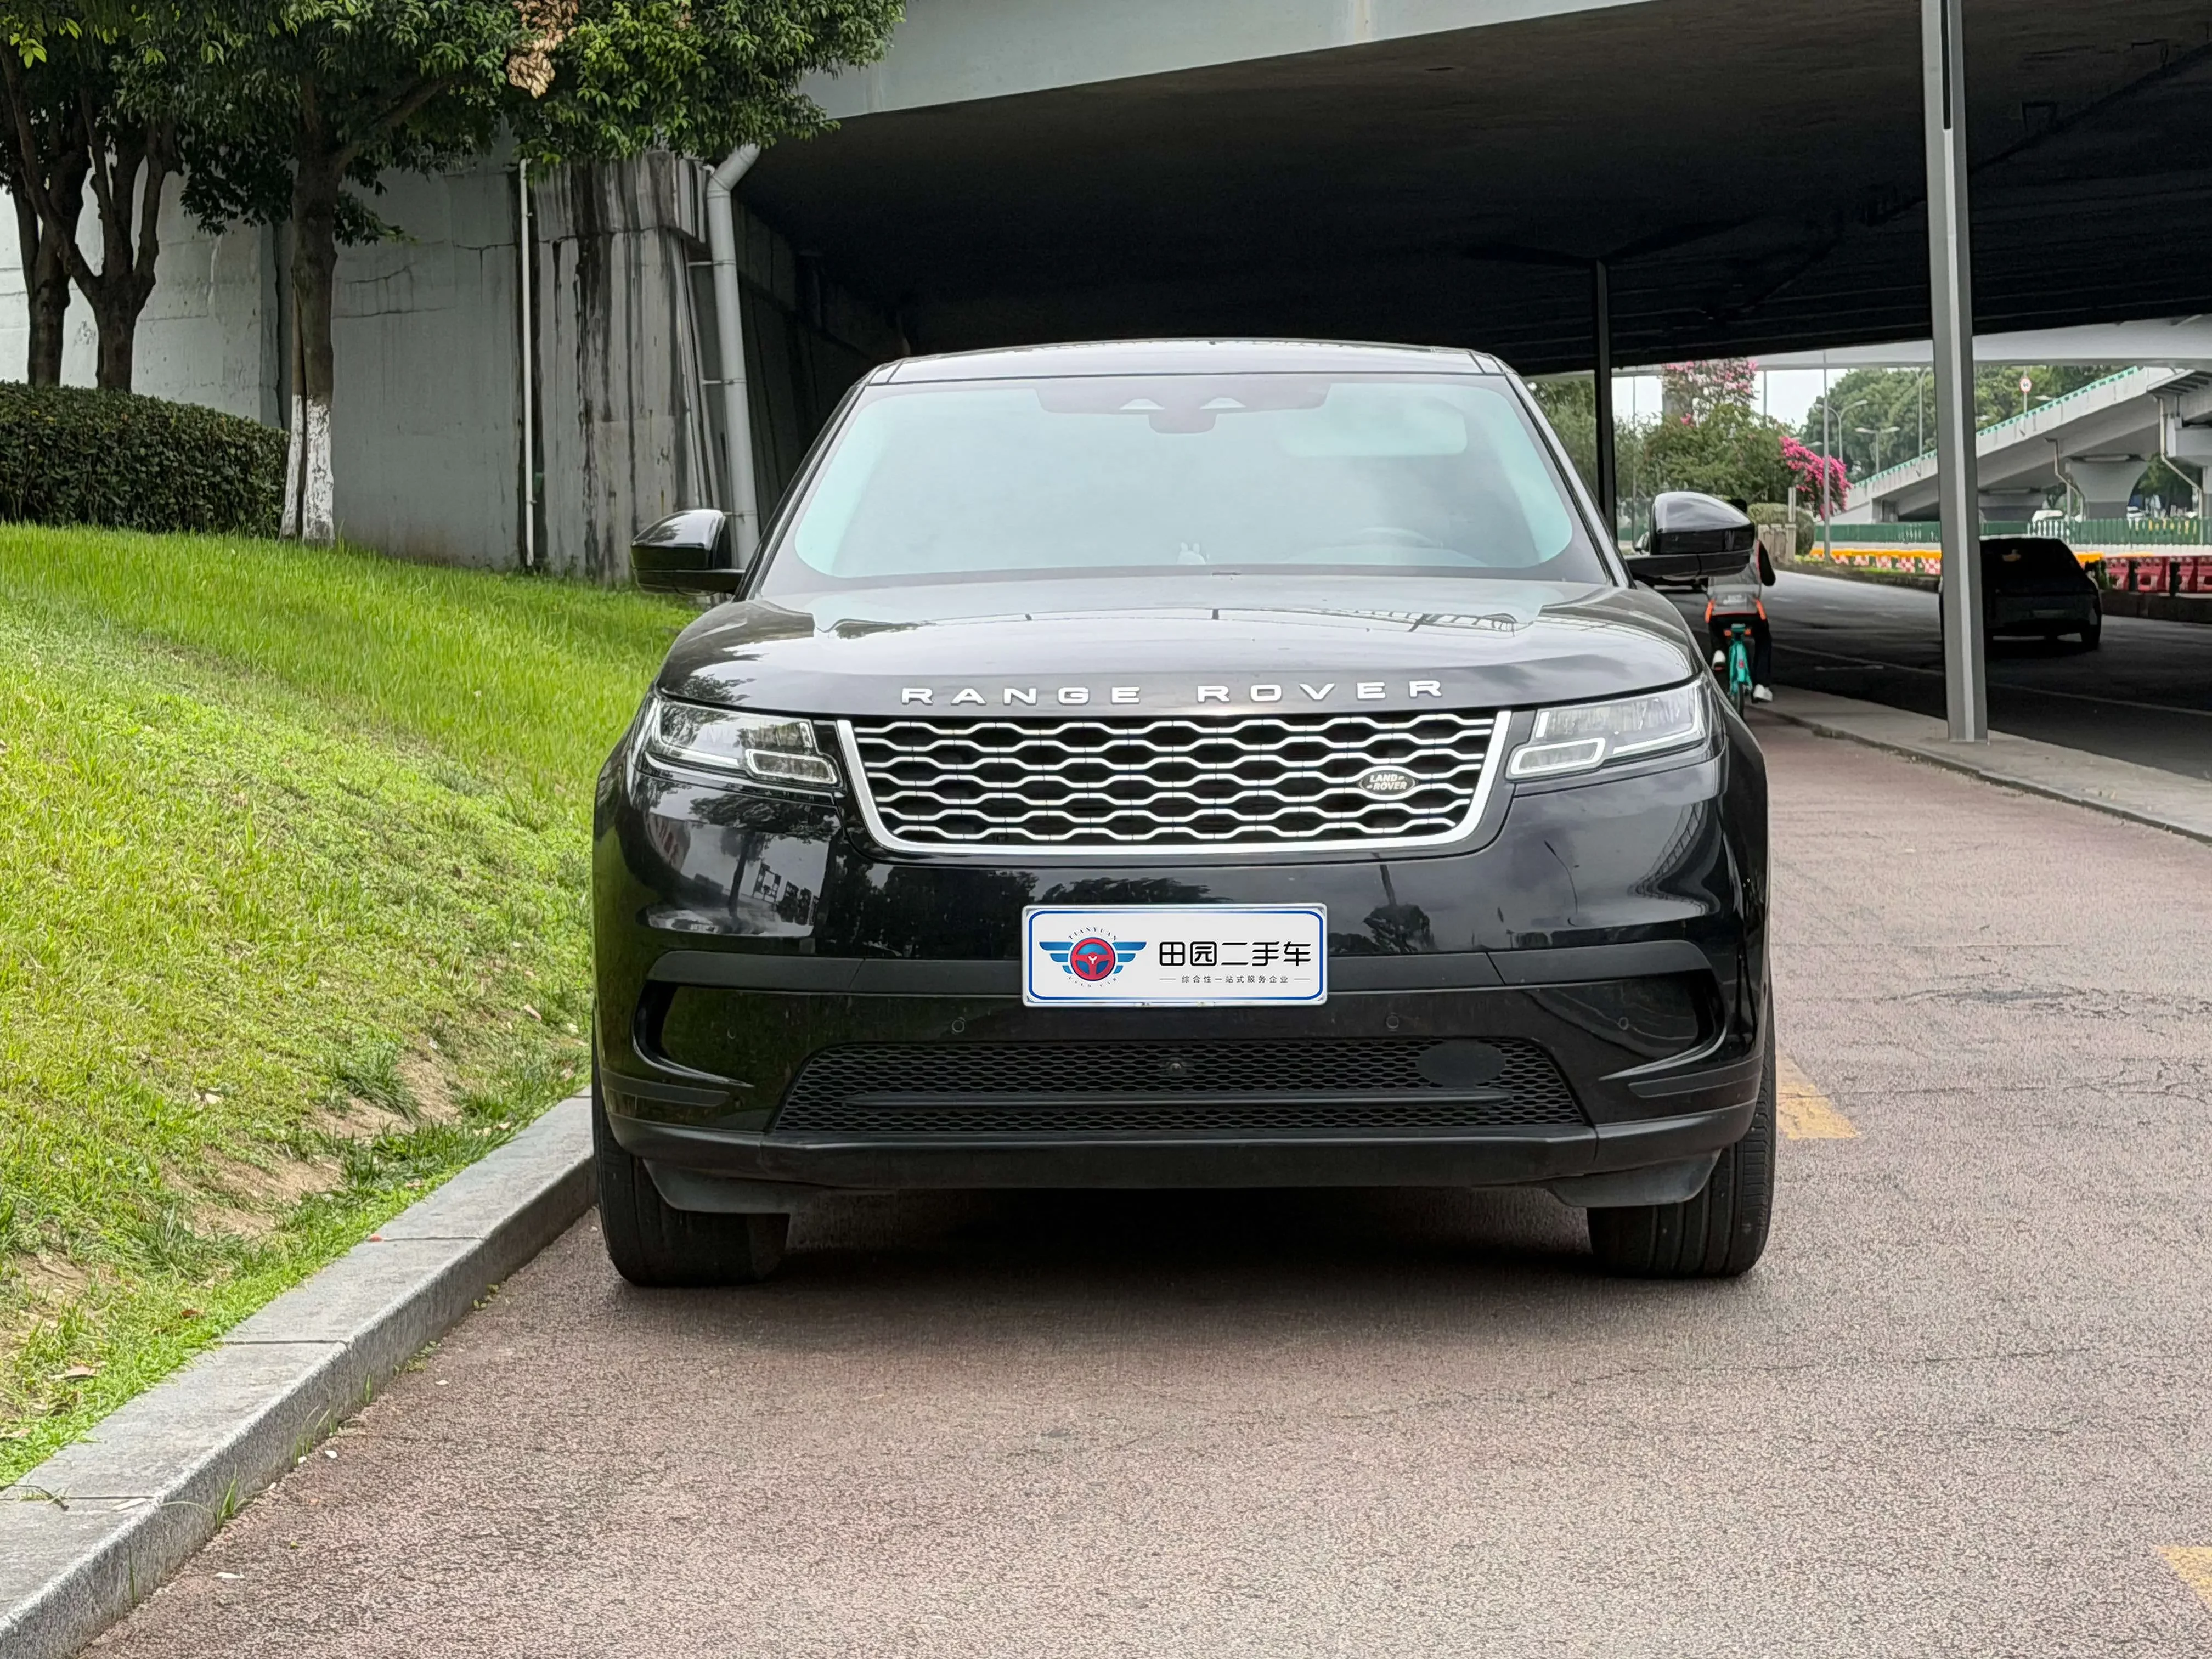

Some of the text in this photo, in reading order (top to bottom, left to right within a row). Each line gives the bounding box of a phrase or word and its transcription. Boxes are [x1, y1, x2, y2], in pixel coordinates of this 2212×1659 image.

[901, 680, 1442, 705] RANGE ROVER
[1159, 941, 1311, 967] 田园二手车
[1181, 975, 1289, 984] 综合性一站式服务企业
